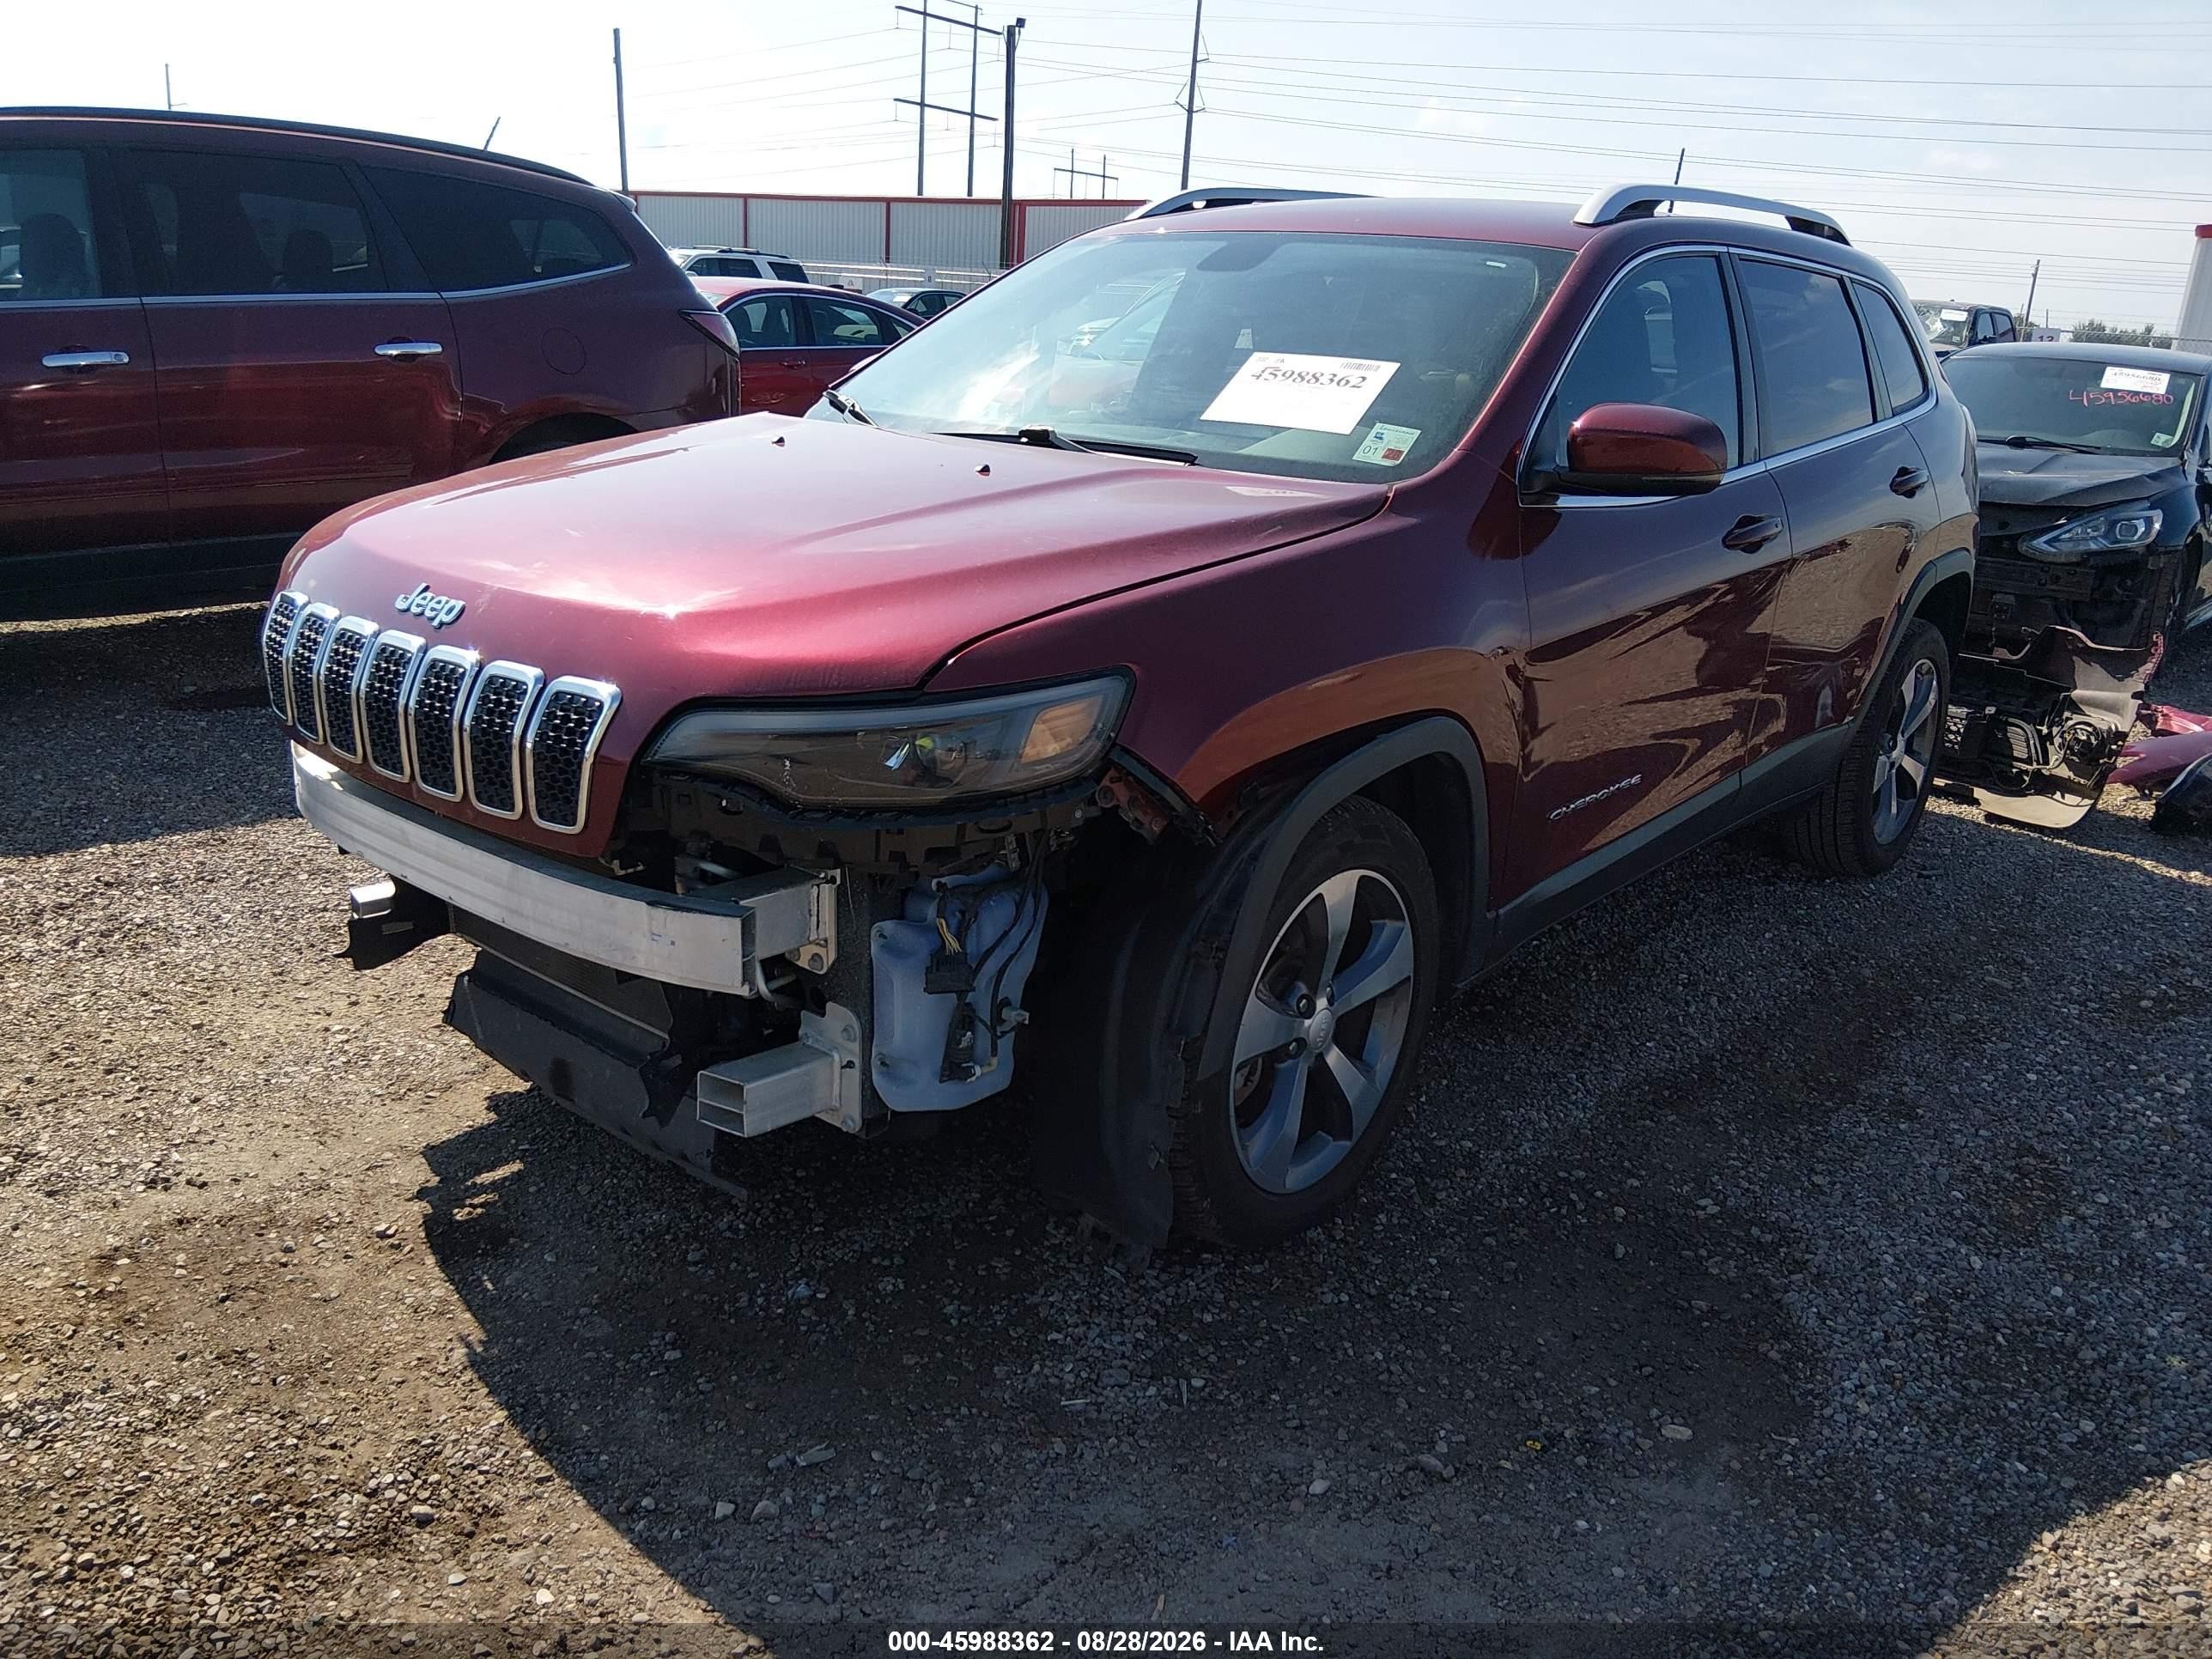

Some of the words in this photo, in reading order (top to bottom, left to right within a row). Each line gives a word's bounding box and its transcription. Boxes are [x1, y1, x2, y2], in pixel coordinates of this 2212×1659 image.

[1250, 366, 1367, 388] 45988362
[1363, 446, 1377, 455] 01
[395, 582, 466, 629] Jeep
[1547, 774, 1642, 821] CHEROKEE
